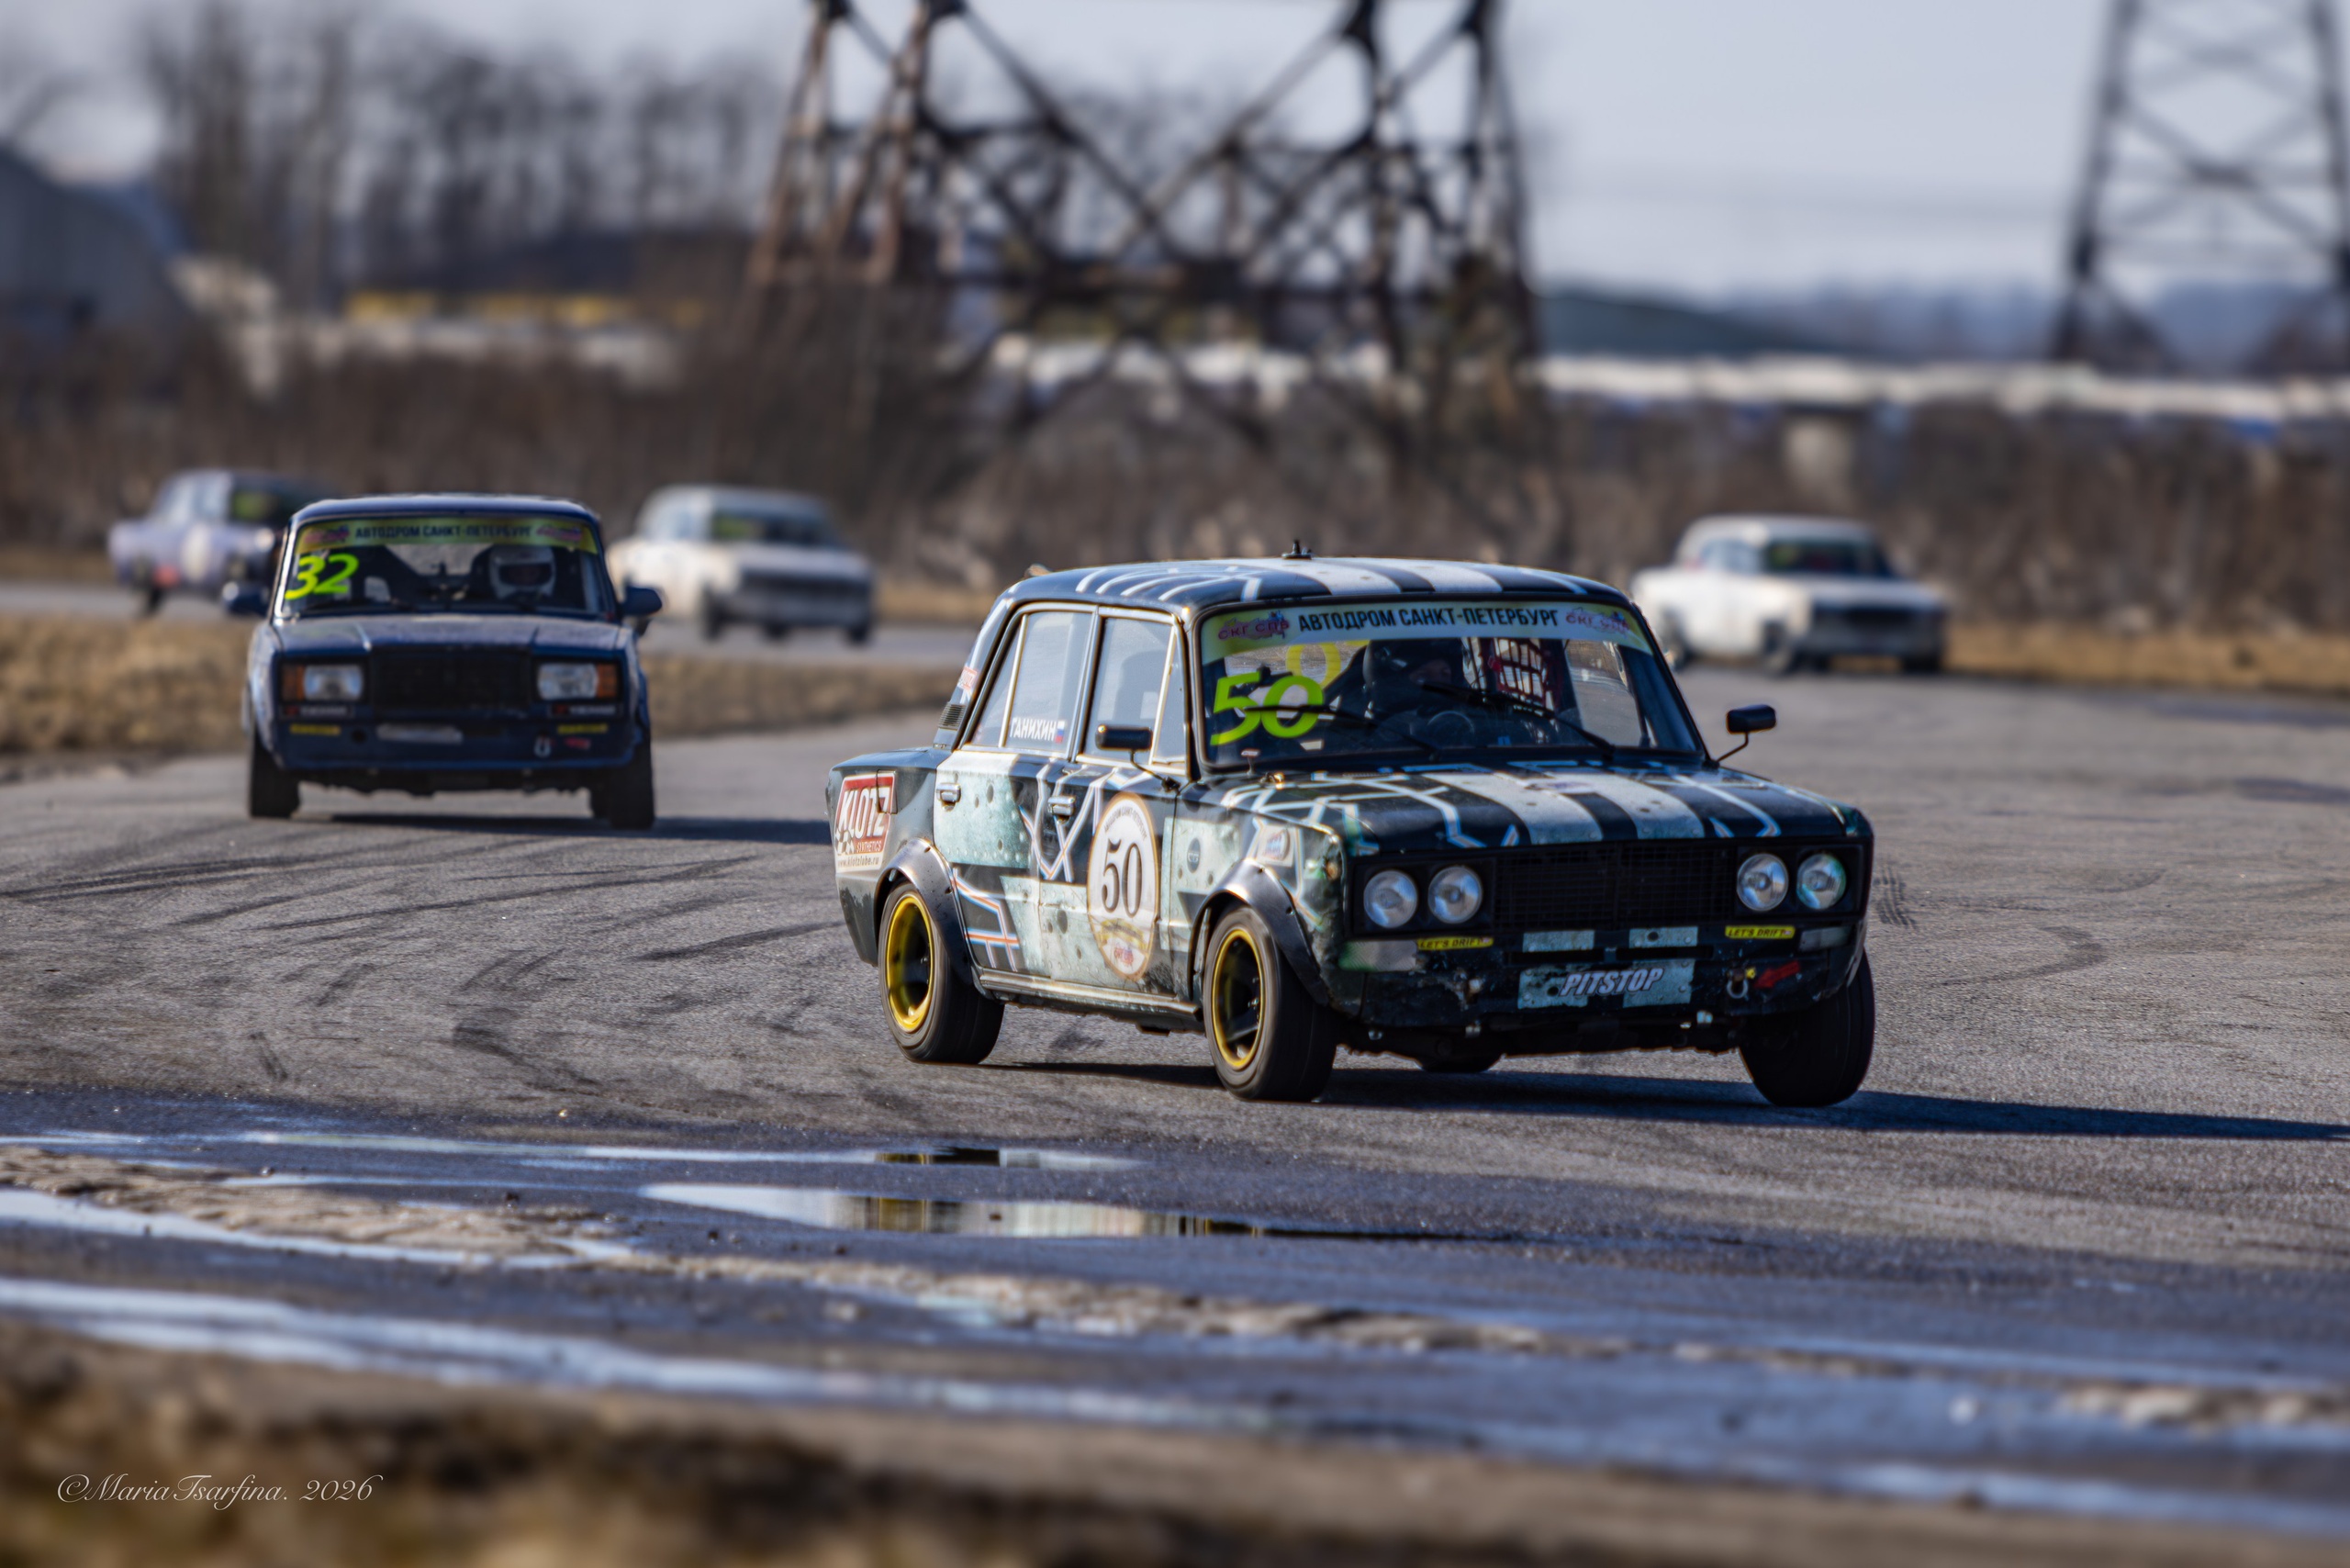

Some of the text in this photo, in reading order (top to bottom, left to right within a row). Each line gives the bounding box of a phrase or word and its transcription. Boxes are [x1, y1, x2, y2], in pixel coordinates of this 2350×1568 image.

[285, 553, 359, 599] 32
[1298, 607, 1559, 632] АВТОДРОМ САНКТ-ПЕТЕРБУРГ
[1210, 671, 1324, 745] 50
[1009, 717, 1057, 742] ГАНИХИН
[837, 787, 890, 838] KLOTZ
[1102, 837, 1143, 918] 50
[1418, 939, 1449, 950] LET'S
[1729, 927, 1786, 937] LET'S DRIFT
[1560, 967, 1664, 998] PITSTOP
